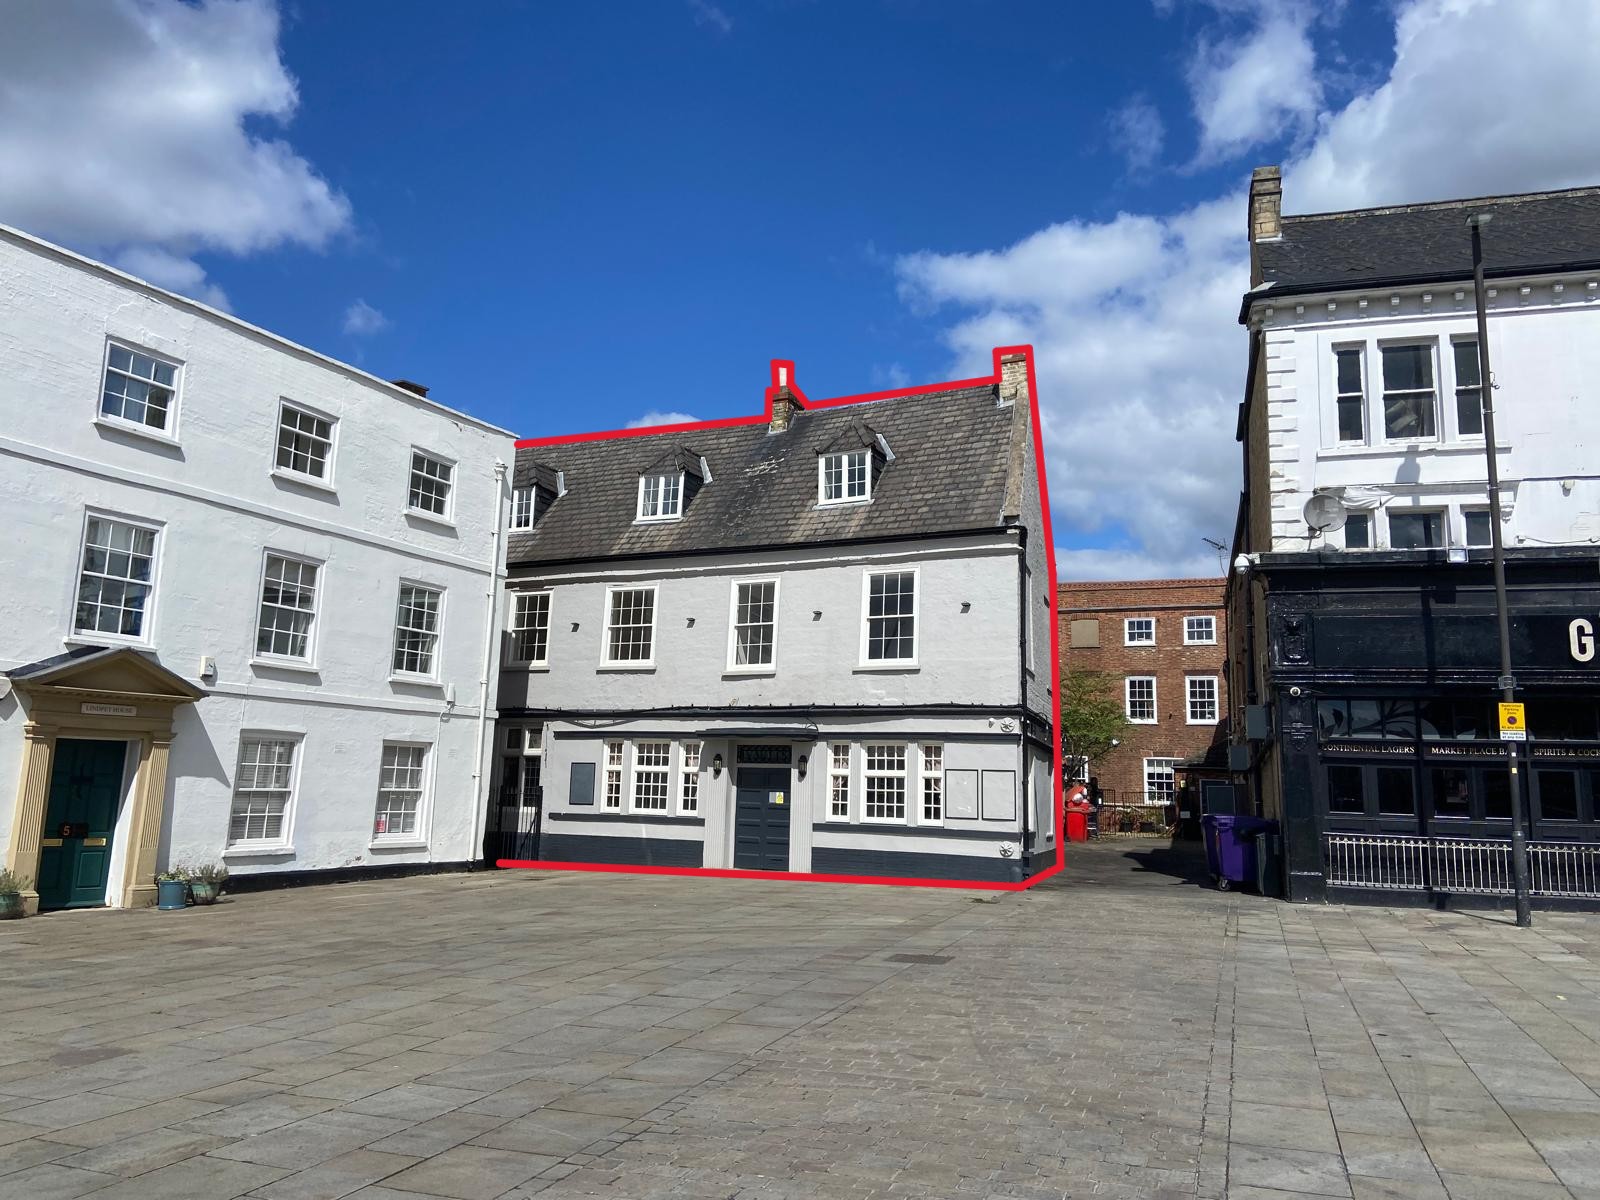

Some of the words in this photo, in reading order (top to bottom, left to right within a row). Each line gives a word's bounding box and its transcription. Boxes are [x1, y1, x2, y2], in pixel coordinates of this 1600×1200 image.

[1569, 618, 1595, 662] G
[112, 706, 134, 714] HOUSE
[1381, 745, 1415, 754] LAGERS
[1431, 746, 1467, 755] MARKET
[1469, 747, 1498, 755] PLACE
[1534, 748, 1566, 756] SPIRITS
[63, 825, 70, 836] 5
